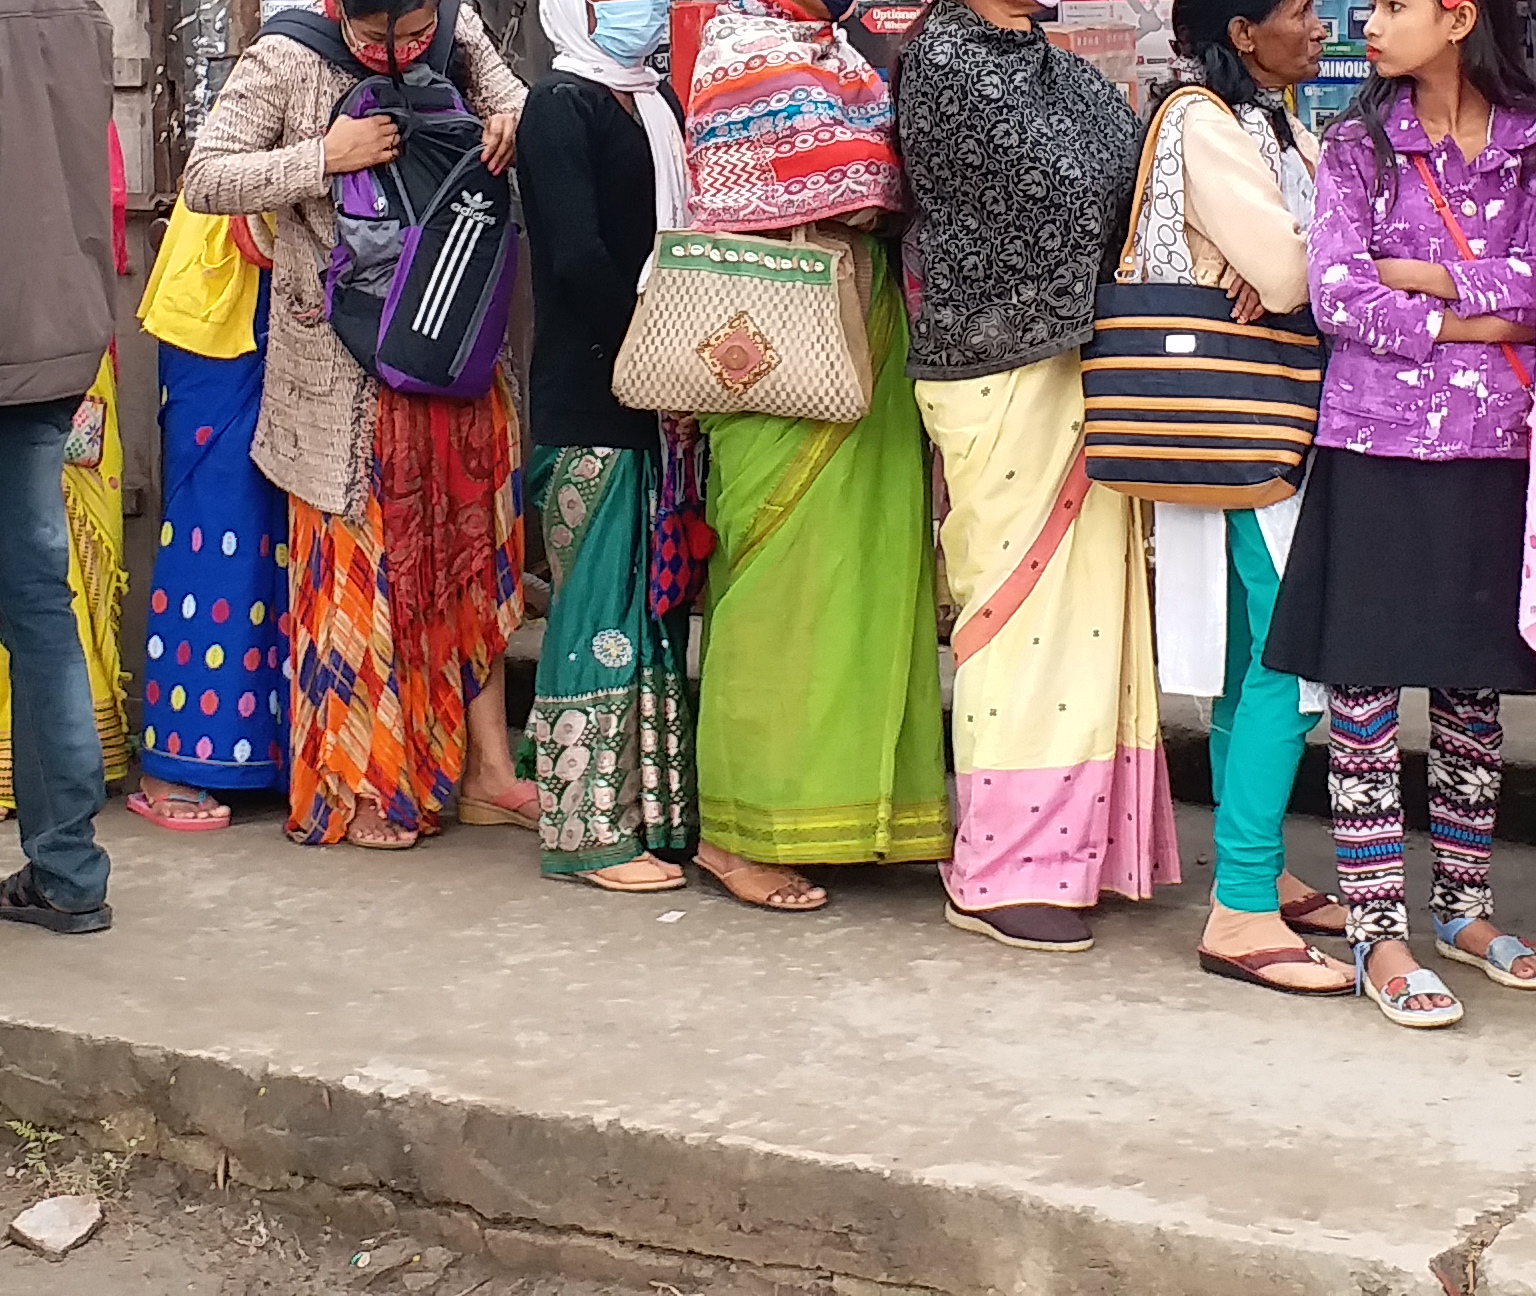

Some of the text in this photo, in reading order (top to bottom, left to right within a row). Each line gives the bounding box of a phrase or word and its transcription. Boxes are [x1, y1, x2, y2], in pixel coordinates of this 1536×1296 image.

[872, 7, 921, 21] Optional
[1318, 60, 1371, 79] MINOUS
[450, 201, 497, 226] adidas
